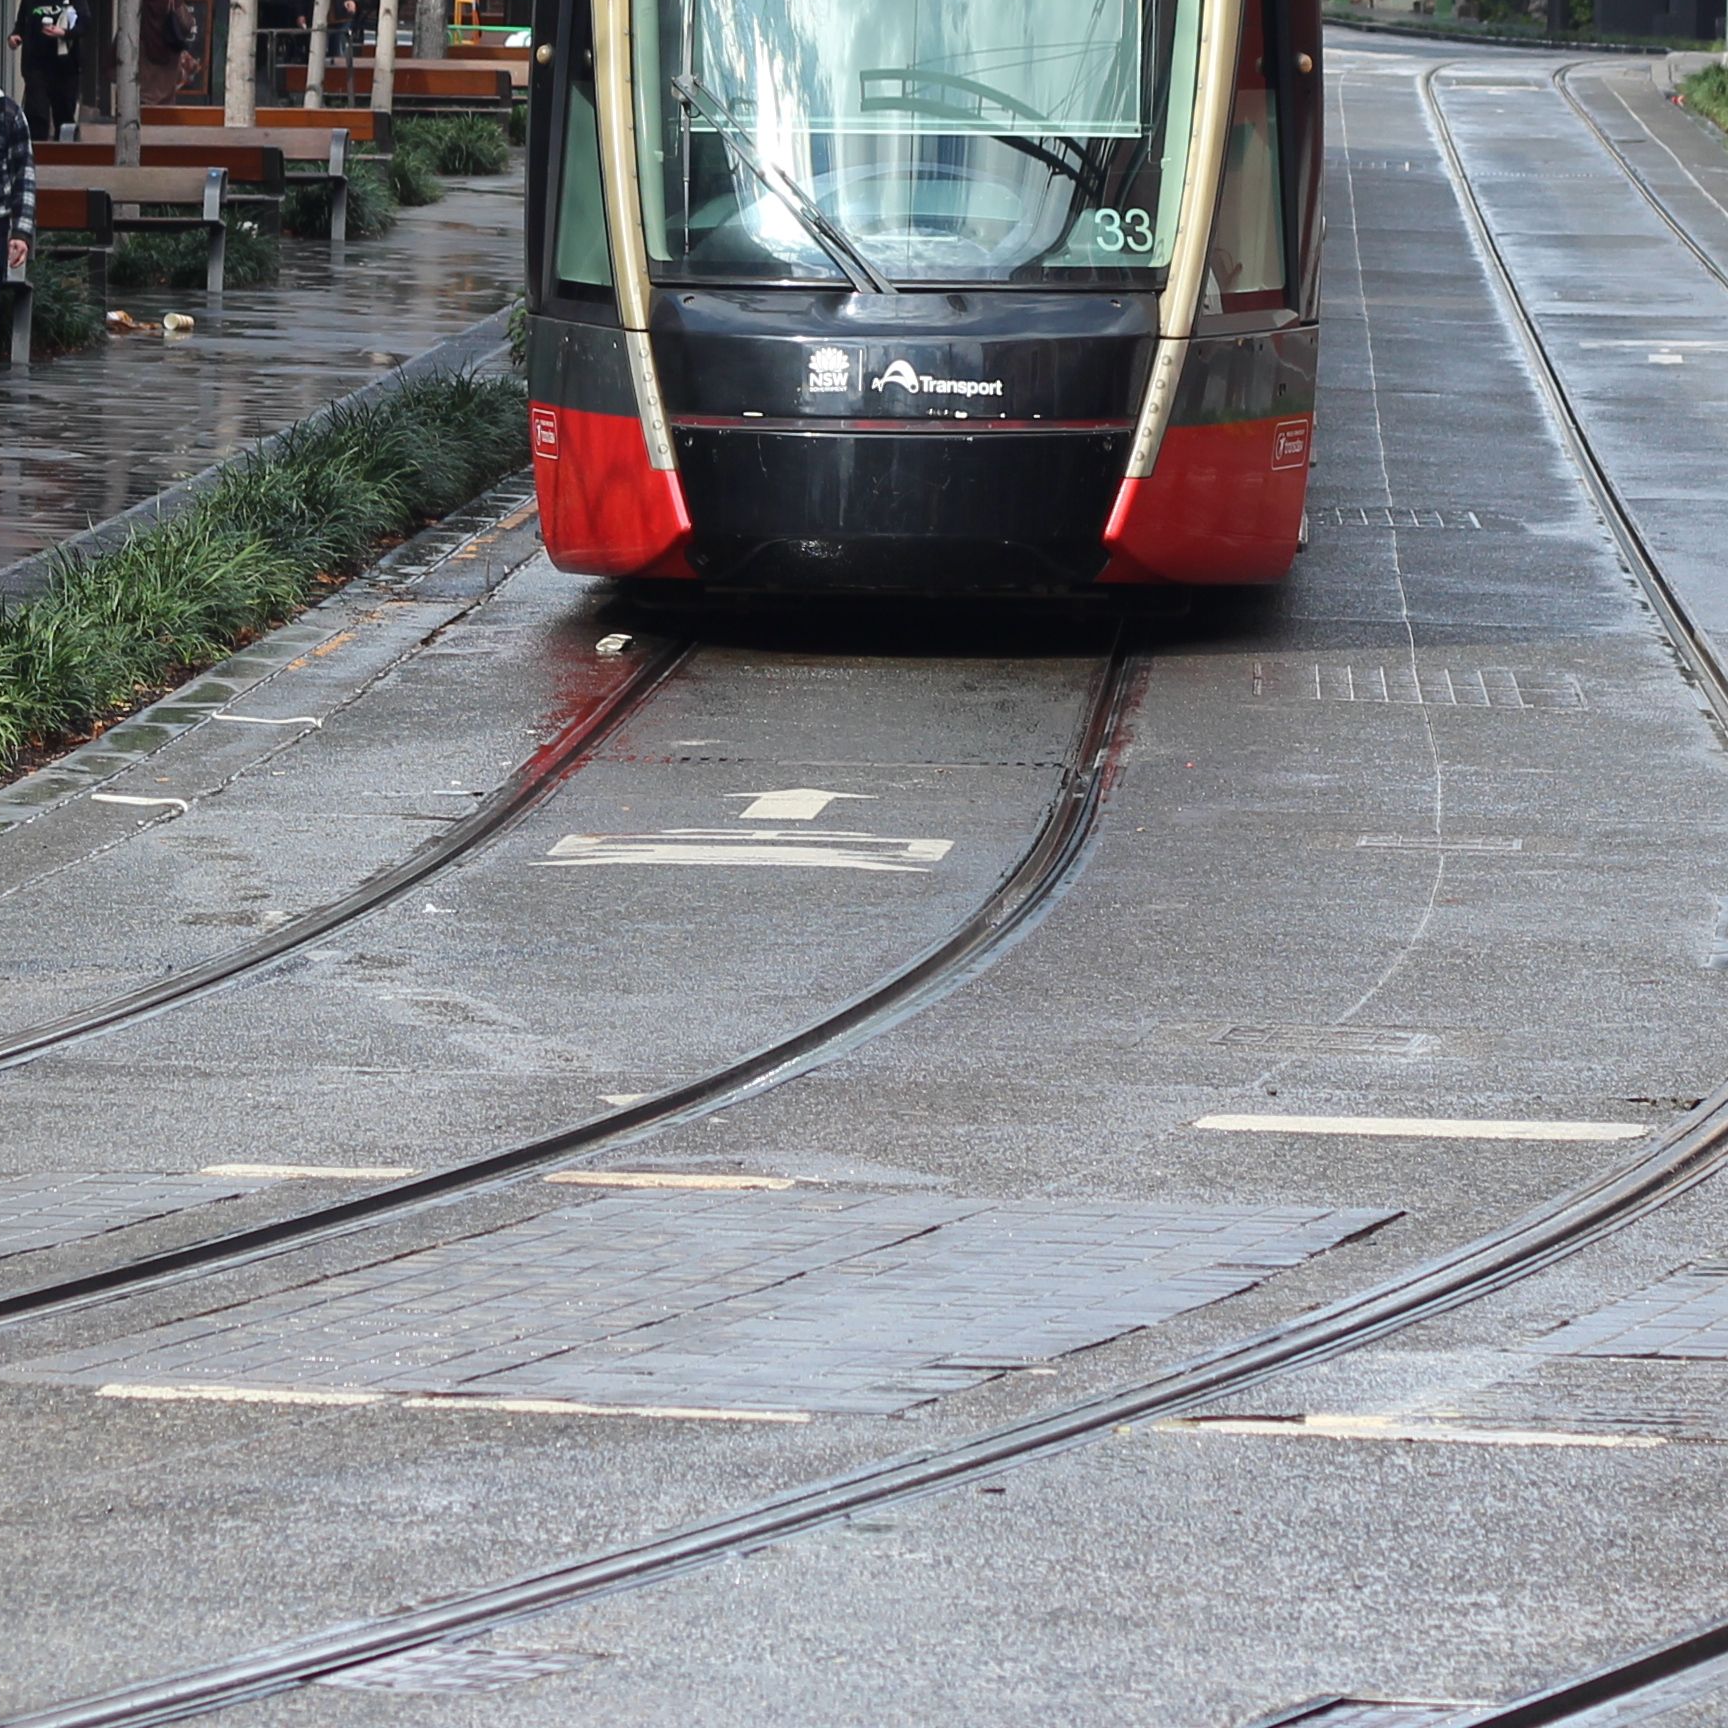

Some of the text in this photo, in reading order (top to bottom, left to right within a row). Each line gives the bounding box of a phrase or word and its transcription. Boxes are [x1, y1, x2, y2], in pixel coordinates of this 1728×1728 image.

[1094, 208, 1154, 253] 33
[809, 372, 1003, 398] NSW Transport
